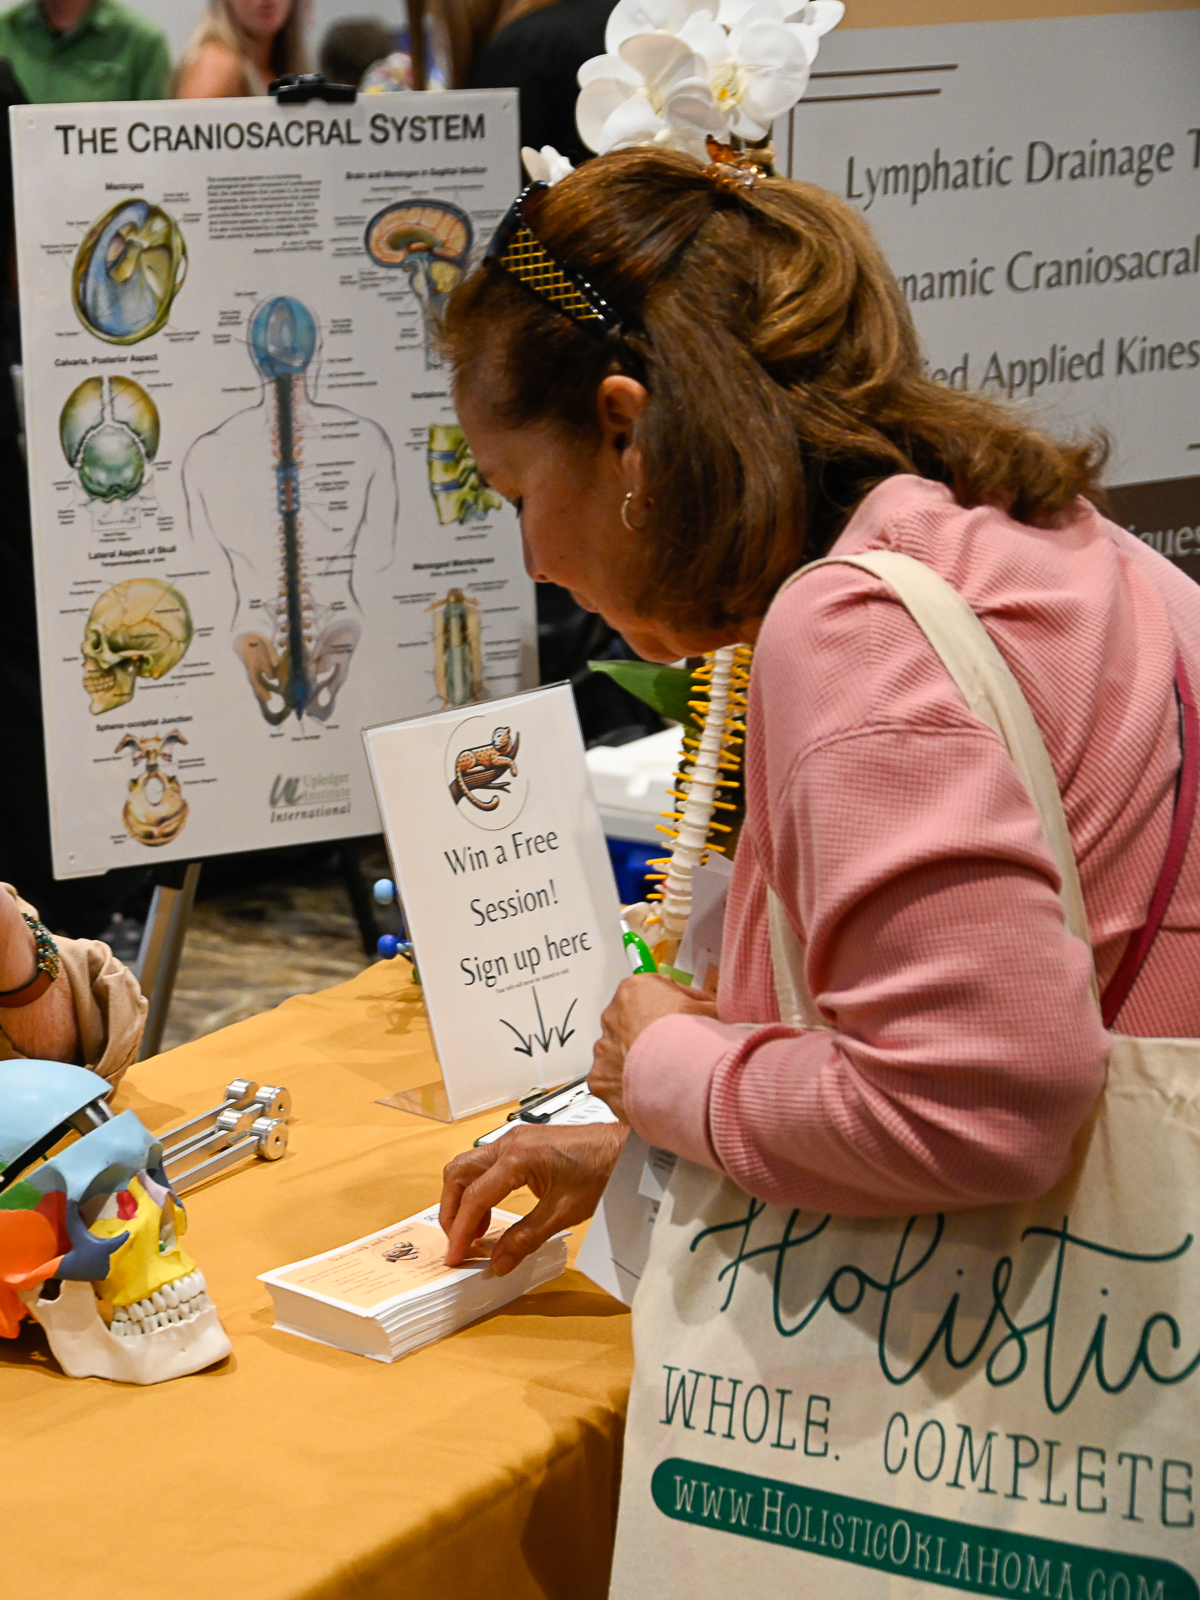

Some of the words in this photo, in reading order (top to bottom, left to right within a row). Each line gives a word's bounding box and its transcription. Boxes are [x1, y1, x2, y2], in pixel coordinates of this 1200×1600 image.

[55, 123, 117, 156] THE
[128, 116, 361, 153] CRANIOSACRAL
[370, 112, 486, 142] SYSTEM
[846, 146, 1013, 210] Lymphatic
[1026, 138, 1174, 185] Drainage
[982, 339, 1105, 398] Applied
[270, 802, 352, 824] International
[445, 847, 488, 876] Win
[496, 844, 508, 864] a
[512, 831, 560, 861] Free
[470, 880, 559, 927] Session!
[459, 956, 509, 988] Sign
[513, 947, 541, 971] up
[545, 931, 593, 961] here
[689, 1196, 1200, 1413] Holistic
[659, 1364, 841, 1463] WHOLE.
